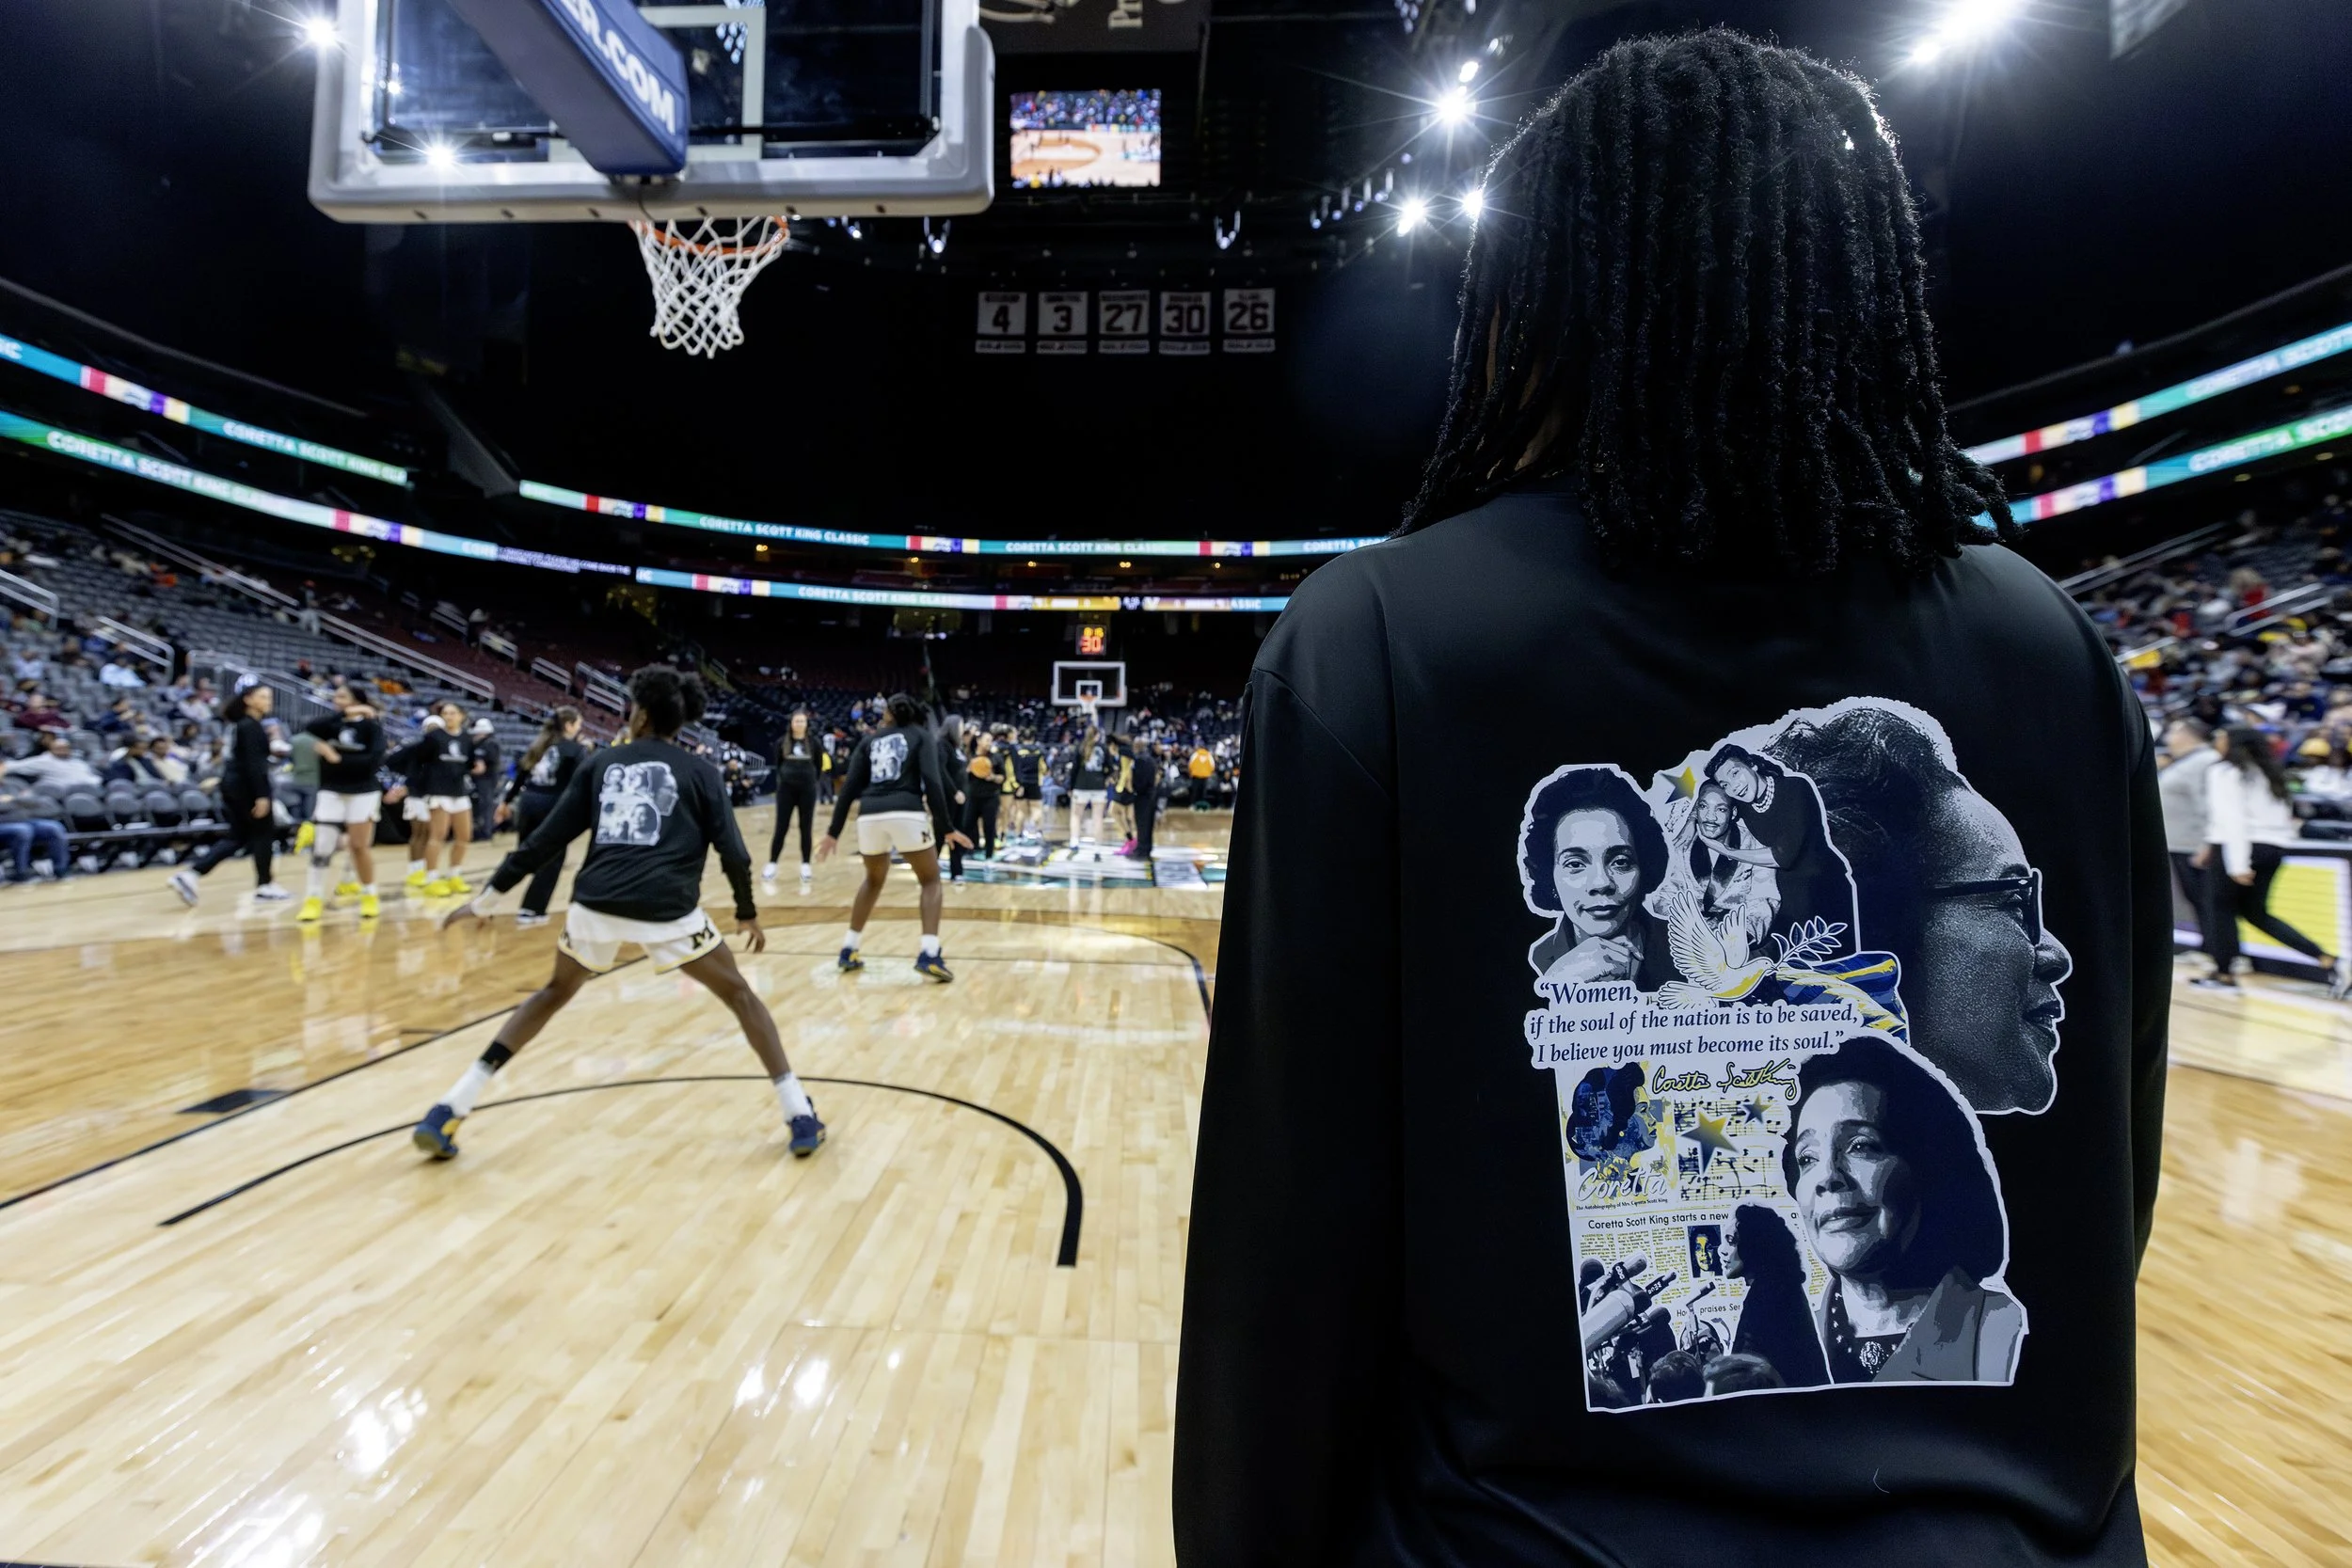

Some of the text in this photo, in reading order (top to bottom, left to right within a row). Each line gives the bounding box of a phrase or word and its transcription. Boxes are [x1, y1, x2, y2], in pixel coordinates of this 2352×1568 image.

[992, 304, 1010, 333] 4
[1053, 305, 1073, 333] 3
[1104, 303, 1144, 332] 27
[1164, 304, 1204, 333] 30
[1228, 301, 1269, 331] 26
[46, 431, 135, 470] CORETTA
[136, 455, 191, 486] SCOTT
[223, 421, 296, 455] CORETTA
[298, 440, 345, 469] SCOTT
[699, 515, 871, 546] CORETTA SCOTT KING CLASSIC
[1005, 542, 1056, 553] CORETTA
[1057, 542, 1093, 553] SCOTT
[798, 586, 850, 601] CORETTA
[851, 591, 888, 603] SCOTT
[1080, 636, 1102, 653] 30
[1539, 982, 1639, 1005] “Women,
[1530, 1003, 1858, 1039] if the soul of the nation is to be saved,
[1537, 1030, 1845, 1064] I believe you must become its soul.”
[1578, 1165, 1668, 1202] Coretta
[1584, 1202, 1616, 1211] Autobiography
[1588, 1219, 1623, 1229] Coretta
[1626, 1217, 1646, 1227] Scott
[1649, 1214, 1669, 1226] King
[1672, 1212, 1697, 1223] starts
[1709, 1212, 1729, 1220] new
[1699, 1305, 1726, 1316] praises
